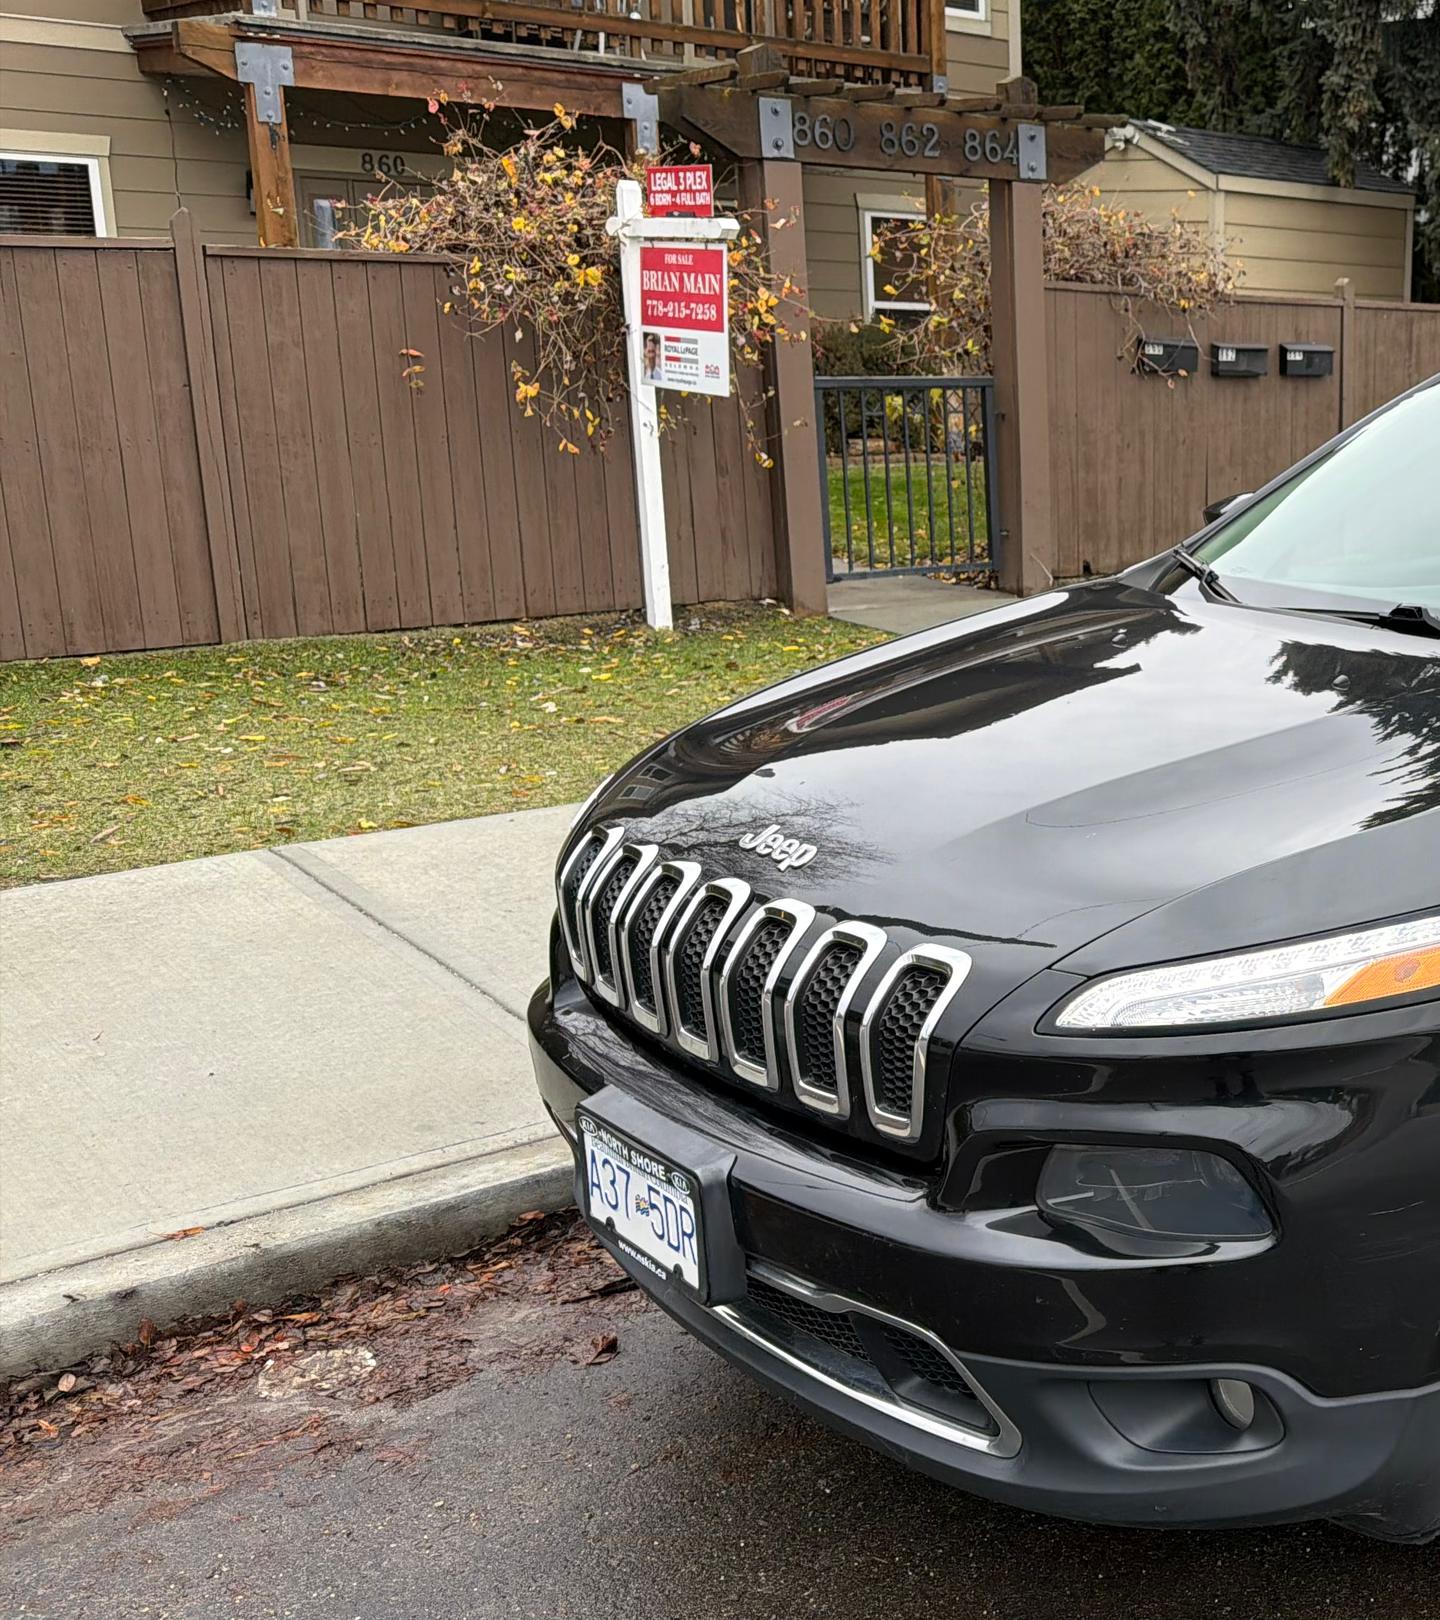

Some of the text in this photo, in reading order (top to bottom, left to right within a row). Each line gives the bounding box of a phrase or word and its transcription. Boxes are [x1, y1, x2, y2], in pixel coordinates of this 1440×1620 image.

[793, 112, 1019, 165] 860 862 864
[361, 152, 406, 175] 860
[650, 171, 707, 191] LEGAL 3 PLEX
[650, 193, 655, 206] 6
[676, 193, 680, 205] 4
[681, 192, 695, 206] FULL
[695, 192, 710, 206] BATH
[664, 254, 693, 266] FOR SALE
[642, 270, 720, 295] BRIAN MAIN
[646, 299, 717, 321] 778-215-7258
[739, 824, 818, 872] Jeep
[600, 1129, 629, 1161] NORTH
[630, 1150, 666, 1181] SHORE
[591, 1149, 630, 1220] A37
[647, 1184, 696, 1265] 5DR
